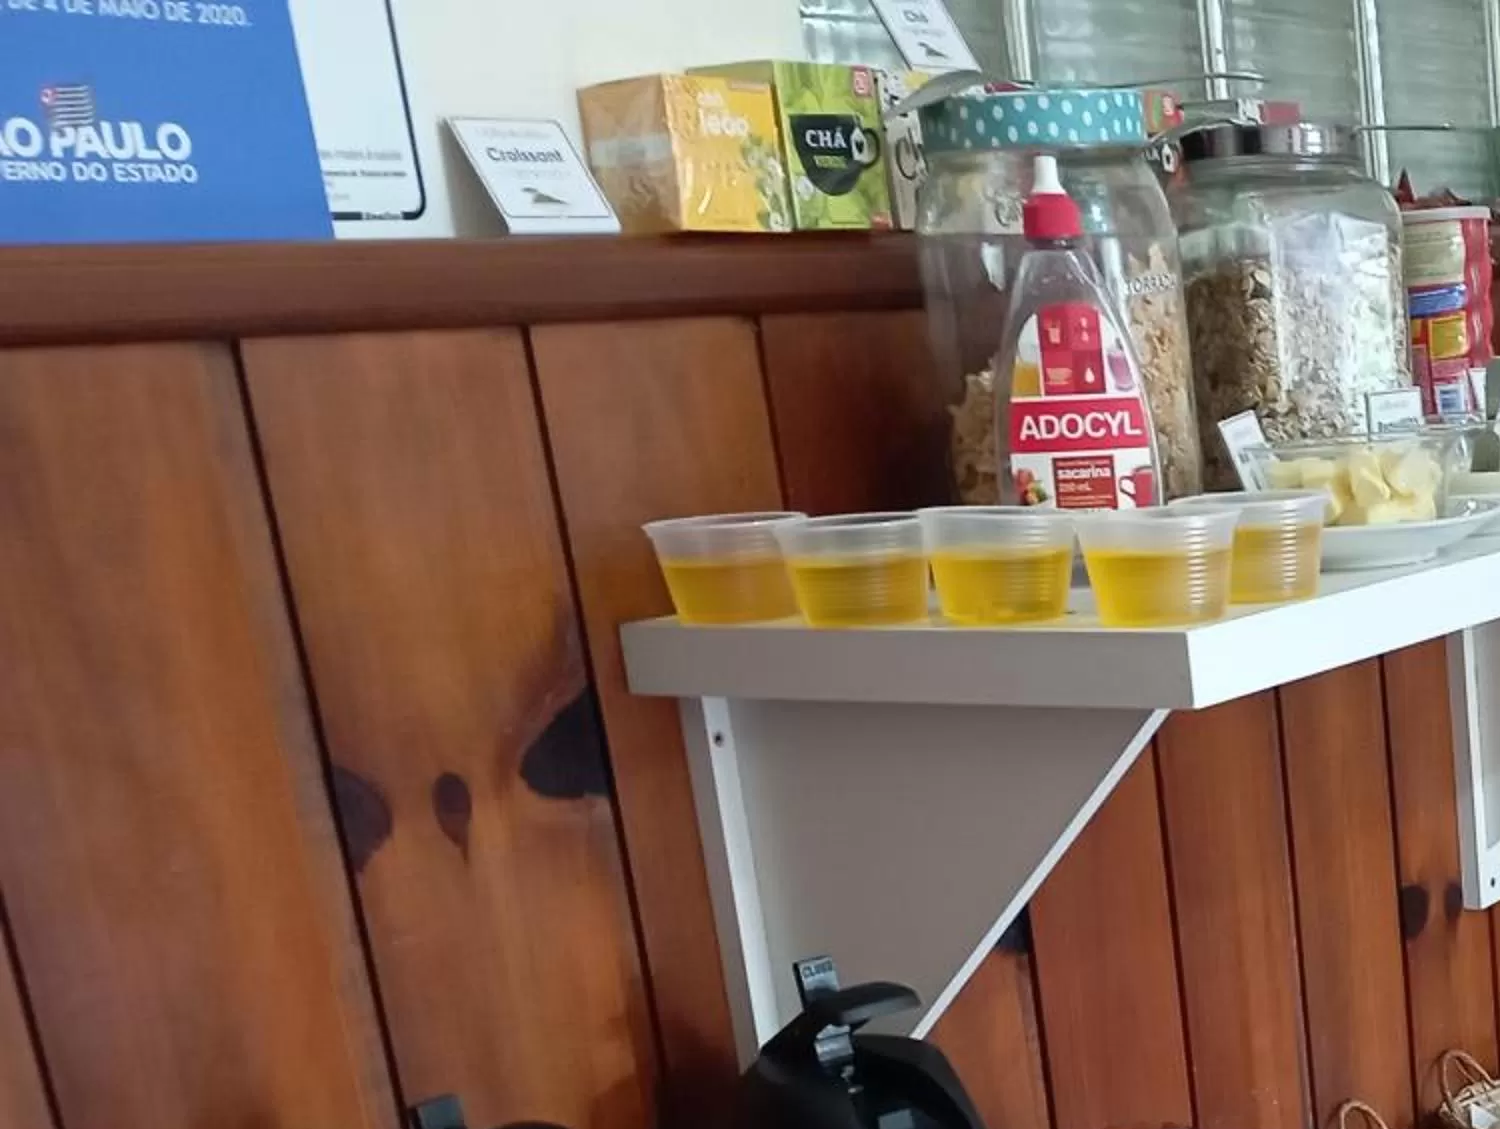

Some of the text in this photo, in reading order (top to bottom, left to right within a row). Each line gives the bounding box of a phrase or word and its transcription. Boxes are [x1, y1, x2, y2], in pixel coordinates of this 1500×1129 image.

[63, 0, 93, 15] DE
[99, 0, 159, 20] MAIO
[164, 1, 193, 22] DE
[50, 121, 192, 161] PAULO
[805, 126, 847, 149] CHÁ
[486, 147, 565, 163] Croissant
[0, 160, 198, 183] ERNO DO ESTADO
[1020, 411, 1142, 441] ADOCYL
[1057, 466, 1111, 480] sacarina
